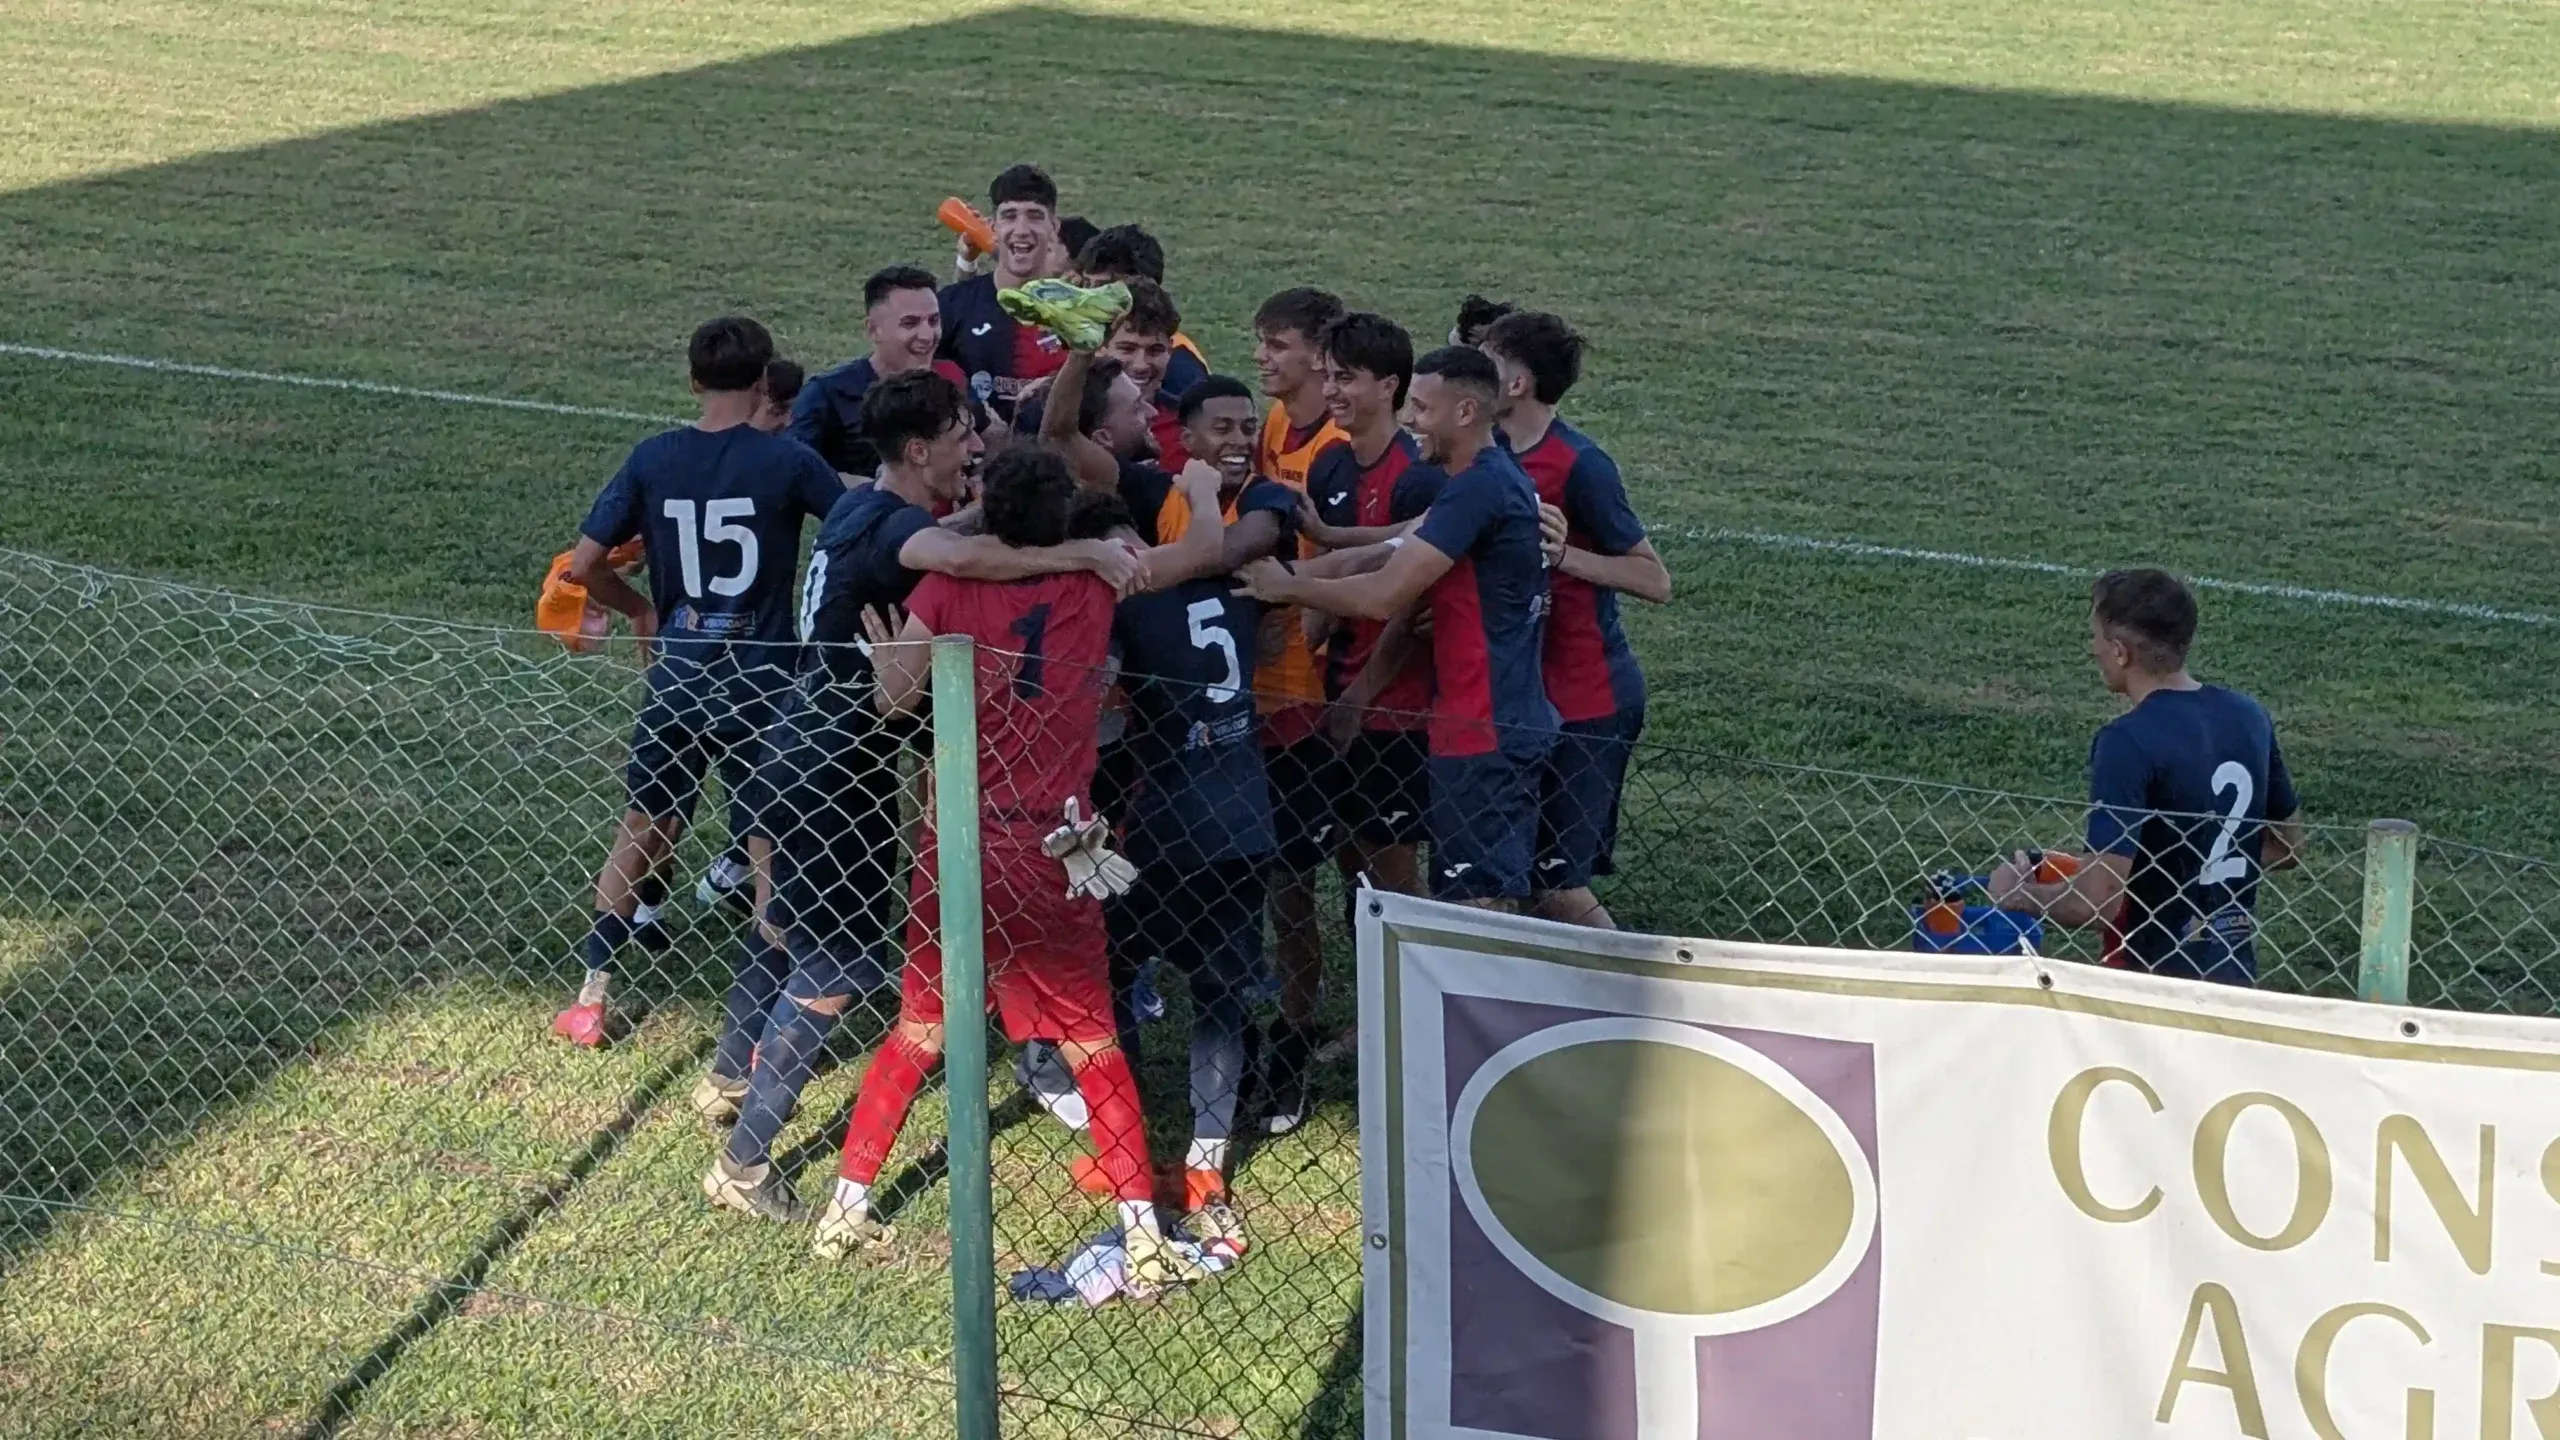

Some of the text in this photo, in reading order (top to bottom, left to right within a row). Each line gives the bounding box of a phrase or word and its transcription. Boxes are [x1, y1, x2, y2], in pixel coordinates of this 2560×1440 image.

[664, 497, 759, 598] 15
[1009, 601, 1052, 699] 1
[1186, 597, 1240, 703] 5
[2199, 760, 2253, 885] 2
[2047, 1066, 2560, 1276] CON
